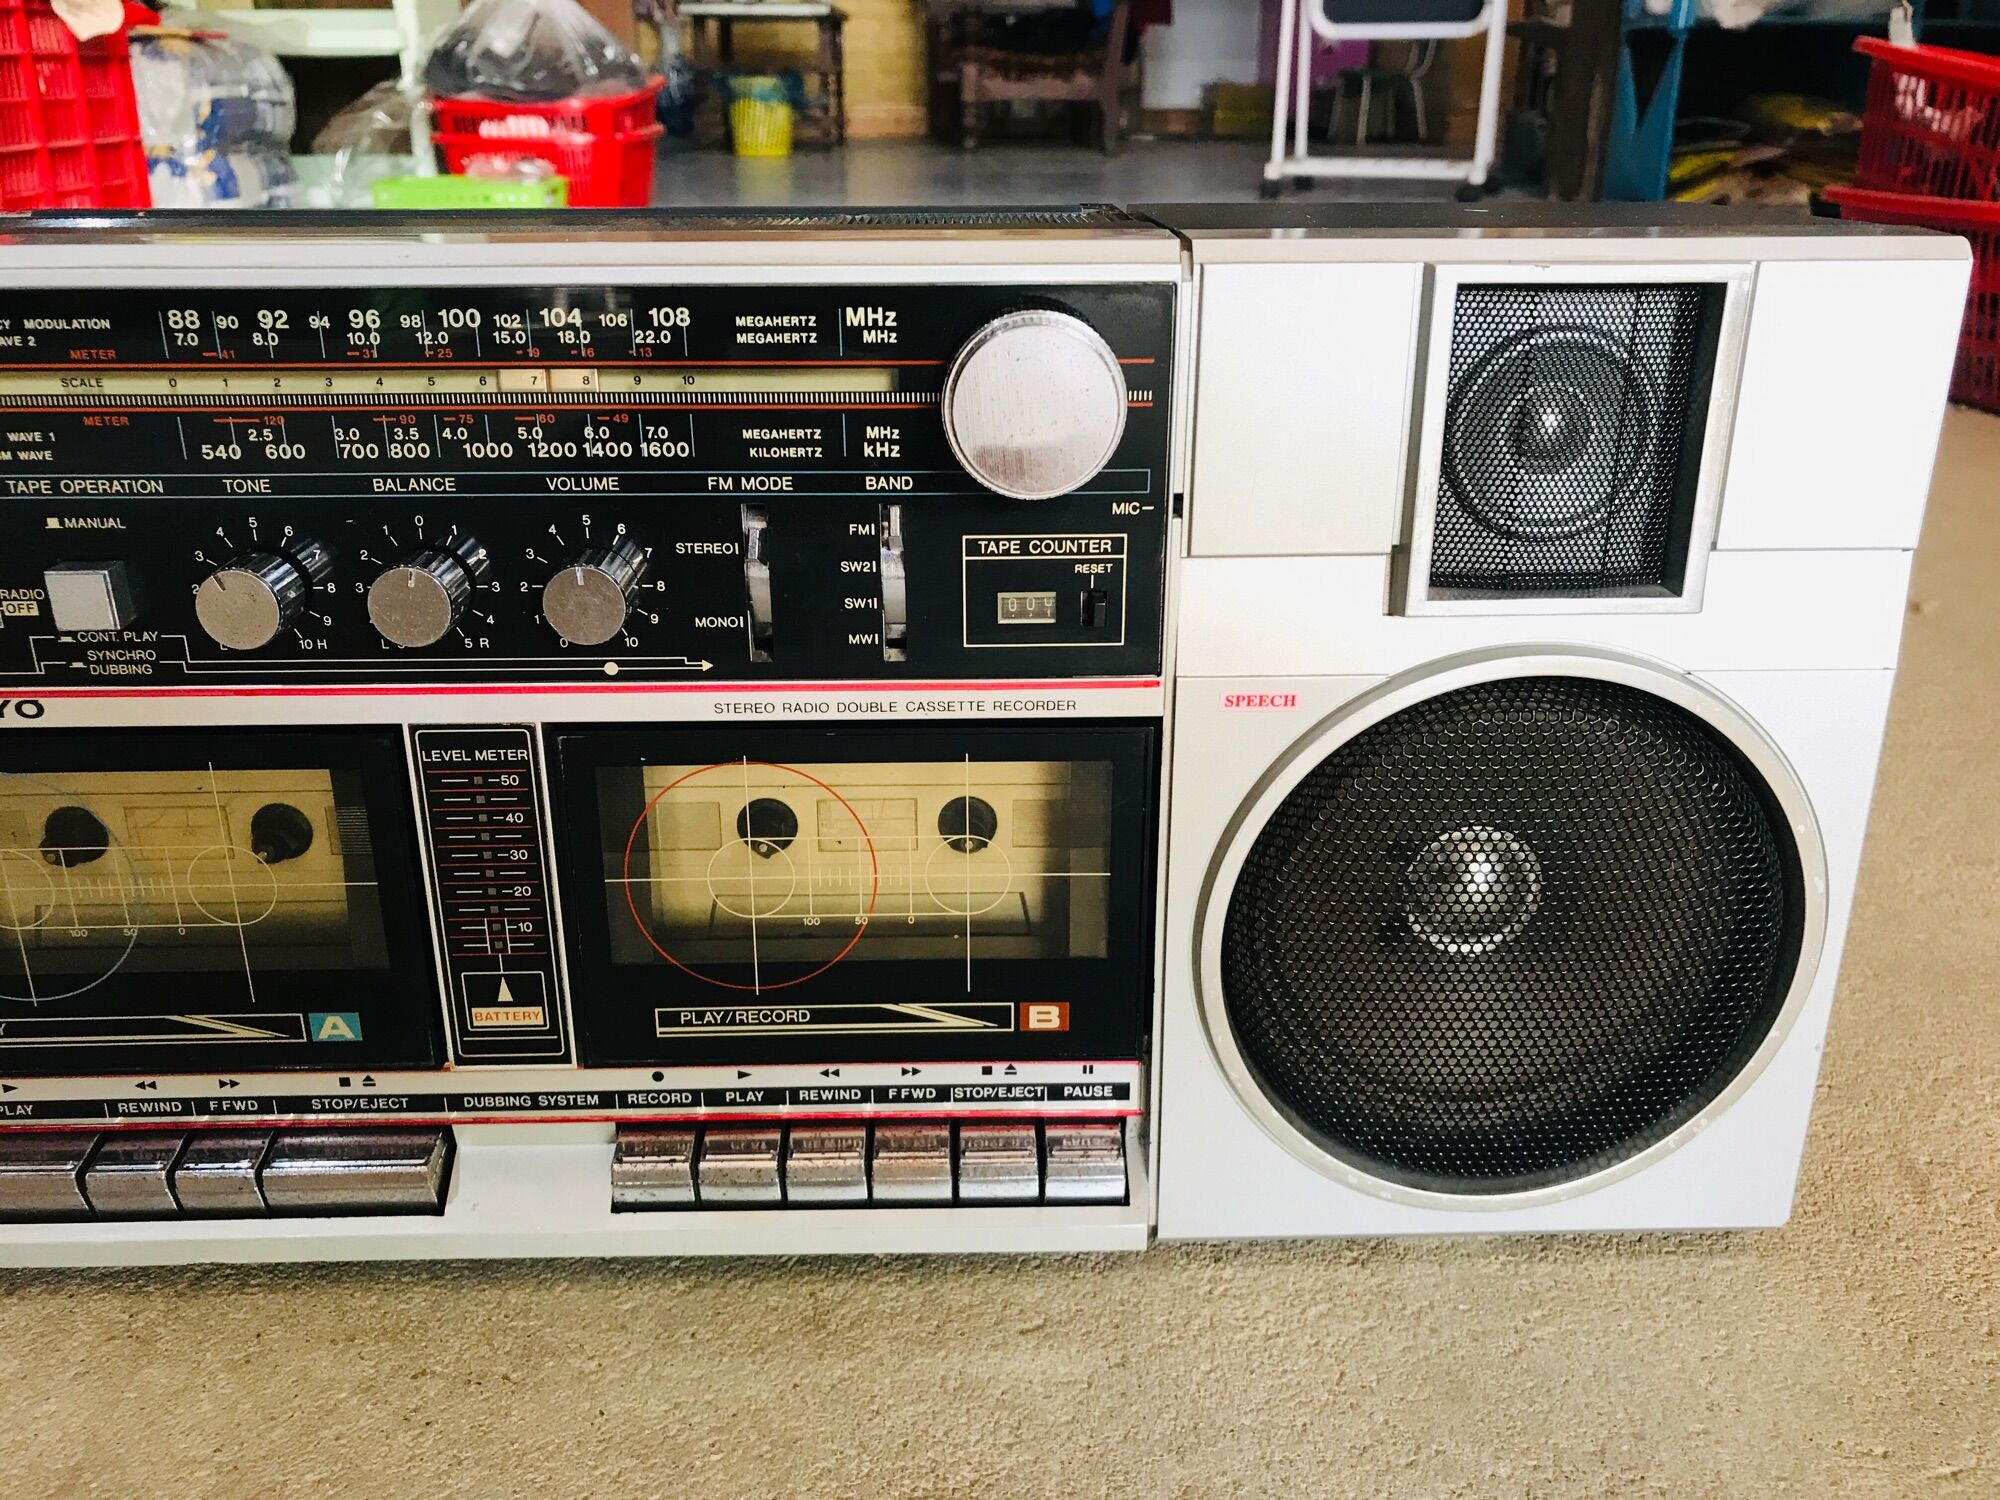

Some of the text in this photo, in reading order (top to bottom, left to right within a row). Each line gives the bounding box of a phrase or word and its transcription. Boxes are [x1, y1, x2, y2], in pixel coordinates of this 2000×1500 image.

[167, 307, 691, 329] 88 90 92 94 96 98 100 102 104 106 108
[735, 307, 897, 327] MEGAHERTZ MHz
[23, 318, 111, 330] MODULATION
[28, 336, 37, 347] 2
[176, 331, 671, 347] 7.0 8.0 10.0 12.0 15.0 18.0 22.0
[736, 329, 897, 344] MEGAHERTZ MHz
[69, 349, 117, 360] METER
[61, 378, 104, 388] SCALE
[168, 376, 695, 388] 0 1 2 3 4 5 6 7 8 9 10
[82, 416, 130, 427] METER
[264, 414, 629, 426] 120 90 75 49
[7, 432, 56, 442] WAVE 1
[247, 426, 668, 441] 2.5 3.0 3.5 4.0 5.0 6.0 7.0
[742, 426, 900, 440] MEGAHERTZ MHz
[17, 451, 54, 461] WAVE
[201, 441, 690, 460] 540 600 700 800 1000 1200 1400 1600
[749, 442, 901, 459] KILOHERTZ kHz
[5, 479, 164, 494] TAPE OPERATION
[223, 479, 272, 493] TONE
[373, 477, 457, 492] BALANCE
[546, 477, 620, 491] VOLUME
[707, 476, 793, 491] FM MODE
[865, 476, 914, 490] BAND
[1112, 502, 1141, 515] MIC
[63, 517, 126, 529] MANUAL
[248, 517, 258, 528] 5
[415, 515, 424, 527] 0
[582, 515, 591, 526] 5
[216, 527, 224, 537] 4
[284, 526, 294, 537] 6
[383, 525, 389, 536] 1
[452, 525, 458, 536] 1
[548, 525, 557, 535] 4
[617, 524, 626, 535] 6
[849, 524, 870, 535] FM
[675, 543, 733, 554] STEREO
[978, 540, 1112, 555] TAPE COUNTER
[195, 551, 204, 562] 3
[360, 550, 368, 560] 2
[526, 548, 534, 559] 3
[645, 548, 653, 559] 7
[840, 562, 870, 573] SW2
[1074, 564, 1113, 574] RESET
[327, 582, 336, 593] 8
[355, 583, 364, 594] 3
[492, 582, 500, 592] 3
[520, 582, 528, 592] 2
[657, 581, 665, 591] 8
[0, 589, 45, 600] RADIO
[5, 603, 35, 614] OFF
[844, 598, 872, 609] SW1
[323, 615, 332, 626] 9
[486, 614, 495, 625] 4
[534, 614, 540, 625] 1
[650, 613, 659, 624] 9
[695, 617, 738, 627] MONO
[124, 631, 158, 642] PLAY
[848, 634, 873, 644] MW
[299, 639, 327, 650] 10 H
[382, 639, 389, 650] L
[464, 637, 490, 649] 5 R
[625, 637, 639, 648] 10
[87, 649, 157, 661] SYNCHRO
[89, 663, 153, 676] DUBBING
[1224, 695, 1297, 707] SPEECH
[714, 700, 1077, 714] STEREO RADIO DOUBLE CASSETTE RECORDER
[422, 749, 528, 762] LEVEL METER
[500, 775, 519, 786] 50
[505, 812, 524, 823] 40
[509, 849, 528, 860] 30
[513, 886, 531, 897] 20
[803, 916, 915, 926] 100 50 0
[518, 922, 532, 932] 10
[474, 1010, 541, 1022] BATTERY
[681, 1009, 811, 1026] PLAY/RECORD
[1029, 1005, 1061, 1029] B
[319, 1016, 354, 1038] A
[725, 1089, 765, 1103] PLAY
[799, 1088, 862, 1102] REWIND
[954, 1086, 1044, 1100] STOP/EJECT
[1063, 1084, 1114, 1098] PAUSE
[311, 1097, 410, 1110] STOP/EJECT
[464, 1093, 599, 1108] DUBBING SYSTEM
[628, 1091, 693, 1105] RECORD
[118, 1100, 183, 1114] REWIND
